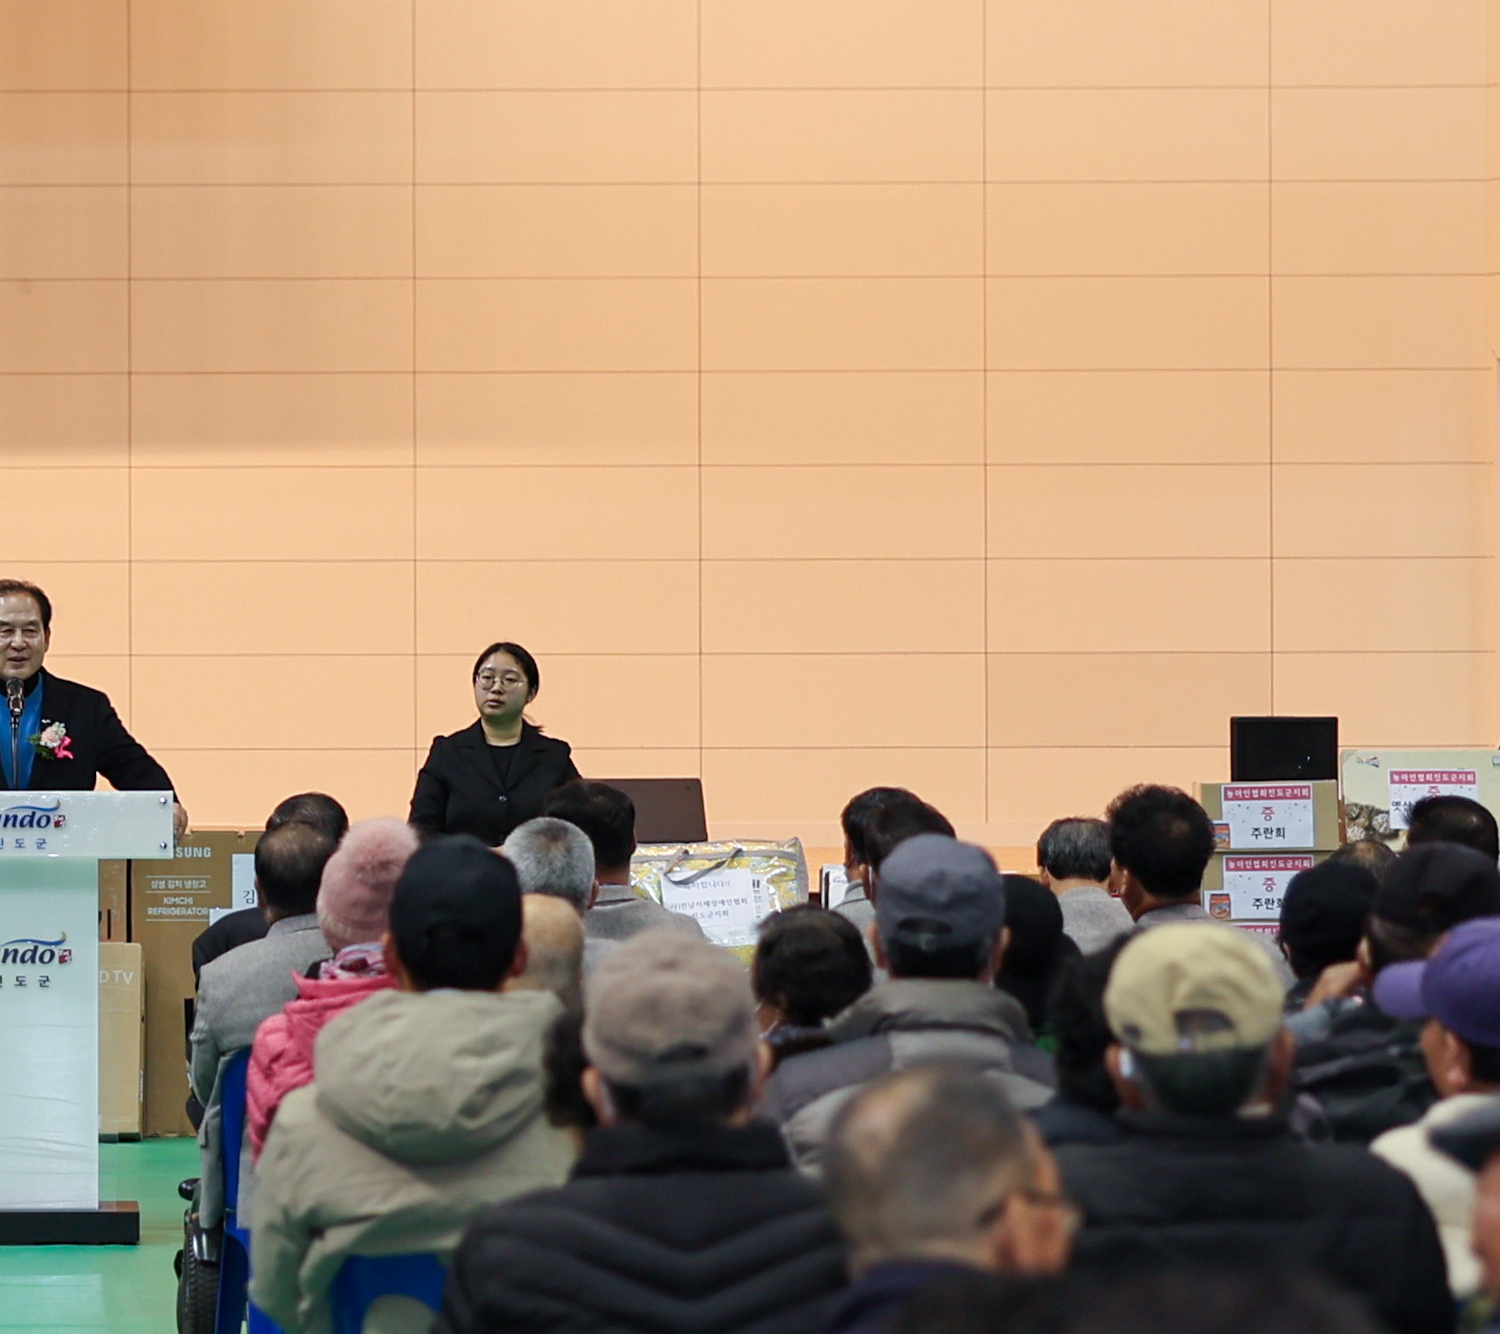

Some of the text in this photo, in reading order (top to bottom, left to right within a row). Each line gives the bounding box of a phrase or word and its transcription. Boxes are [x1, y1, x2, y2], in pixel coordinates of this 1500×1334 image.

[1251, 826, 1286, 840] 주란회
[150, 880, 207, 889] 삼성 김치 냉장고
[163, 897, 194, 905] KIMCHI
[147, 907, 209, 916] REFRIGERATOR
[112, 970, 134, 984] TV
